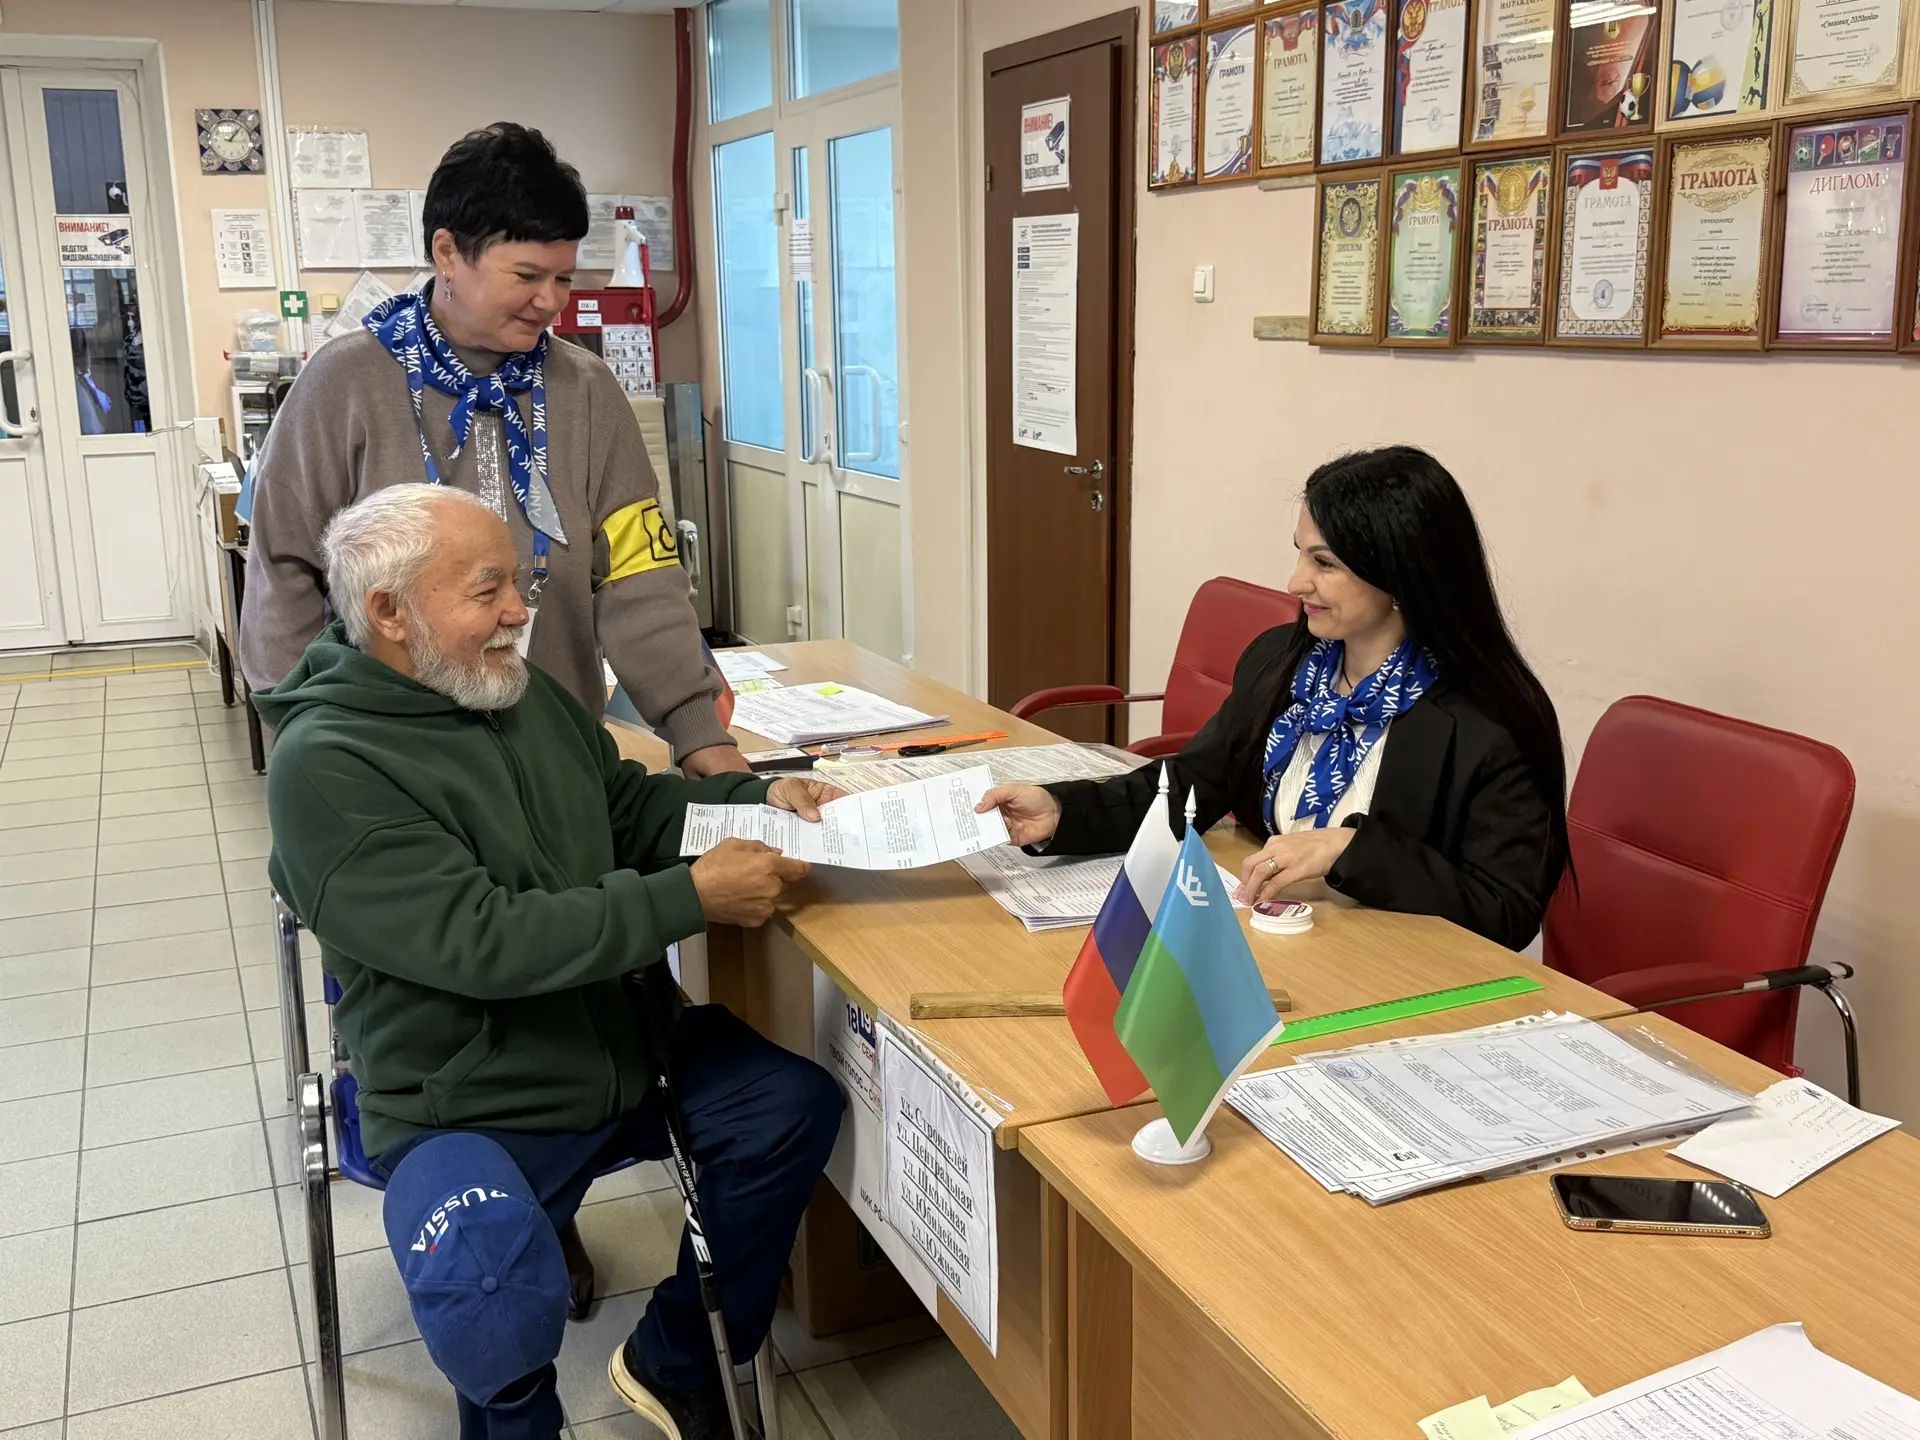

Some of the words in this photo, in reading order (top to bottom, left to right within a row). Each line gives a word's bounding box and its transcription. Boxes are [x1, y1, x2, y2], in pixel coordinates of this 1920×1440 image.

[1219, 65, 1245, 79] ГРАМОТА
[1274, 53, 1308, 69] ГРАМОТА
[1679, 167, 1759, 191] ГРАМОТА
[1809, 172, 1880, 194] ДИПЛОМ
[1584, 195, 1632, 209] ГРАМОТА
[59, 222, 109, 232] ВНИМАНИЕ!
[1409, 215, 1440, 226] ГРАМОТА
[1488, 217, 1534, 231] ГРАМОТА
[405, 344, 422, 374] УИК
[443, 348, 473, 383] УИК
[430, 361, 464, 391] УИК
[533, 403, 546, 432] УИК
[534, 446, 547, 476] УИК
[1381, 684, 1401, 719] УИК
[1304, 771, 1323, 811] УИК
[846, 1002, 858, 1035] 18
[844, 1060, 864, 1089] ГОЛОС
[901, 1096, 914, 1119] ул.
[915, 1107, 968, 1178] Строителей
[673, 1146, 686, 1170] QUALITY
[897, 1121, 910, 1144] ул.
[912, 1131, 973, 1213] Центральная
[903, 1156, 916, 1179] ул.
[918, 1167, 966, 1237] Школьная
[901, 1180, 914, 1206] ул.
[915, 1193, 970, 1271] Юбилейная
[911, 1220, 924, 1245] ул.
[925, 1232, 961, 1289] Южная
